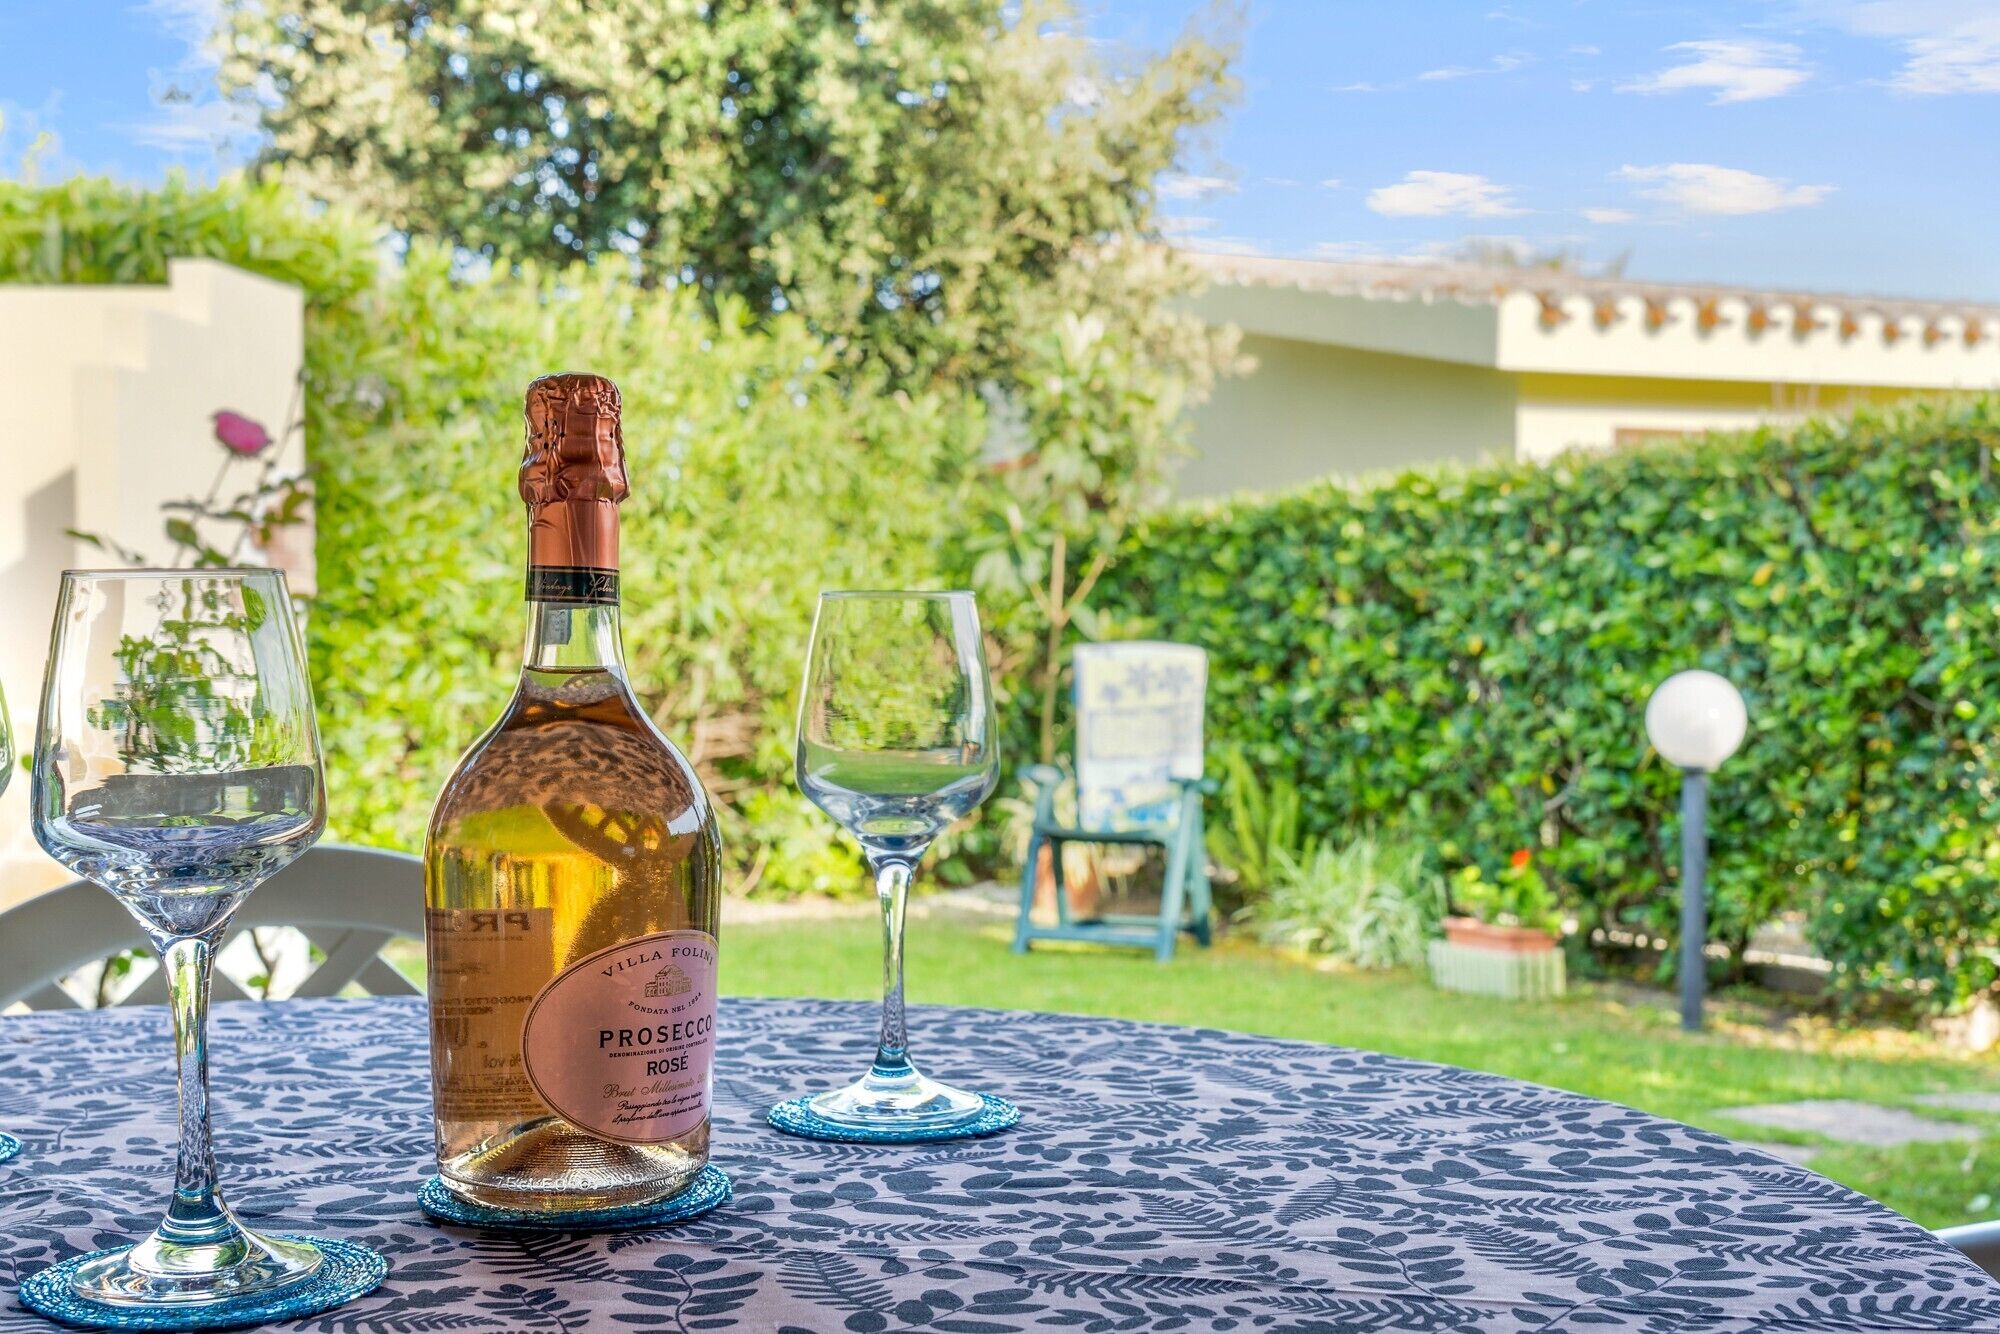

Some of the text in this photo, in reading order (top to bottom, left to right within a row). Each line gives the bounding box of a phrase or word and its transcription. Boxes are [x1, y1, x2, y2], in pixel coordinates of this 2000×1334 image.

[601, 946, 713, 978] VILLA FOLINI
[628, 1000, 669, 1015] FONDATA
[671, 1004, 685, 1014] NEL
[599, 1014, 712, 1049] PROSECCO
[609, 1049, 657, 1058] DENOMINAZIONE
[665, 1044, 685, 1053] ORIGINE
[646, 1050, 689, 1077] ROSÉ
[602, 1083, 637, 1099] Brut
